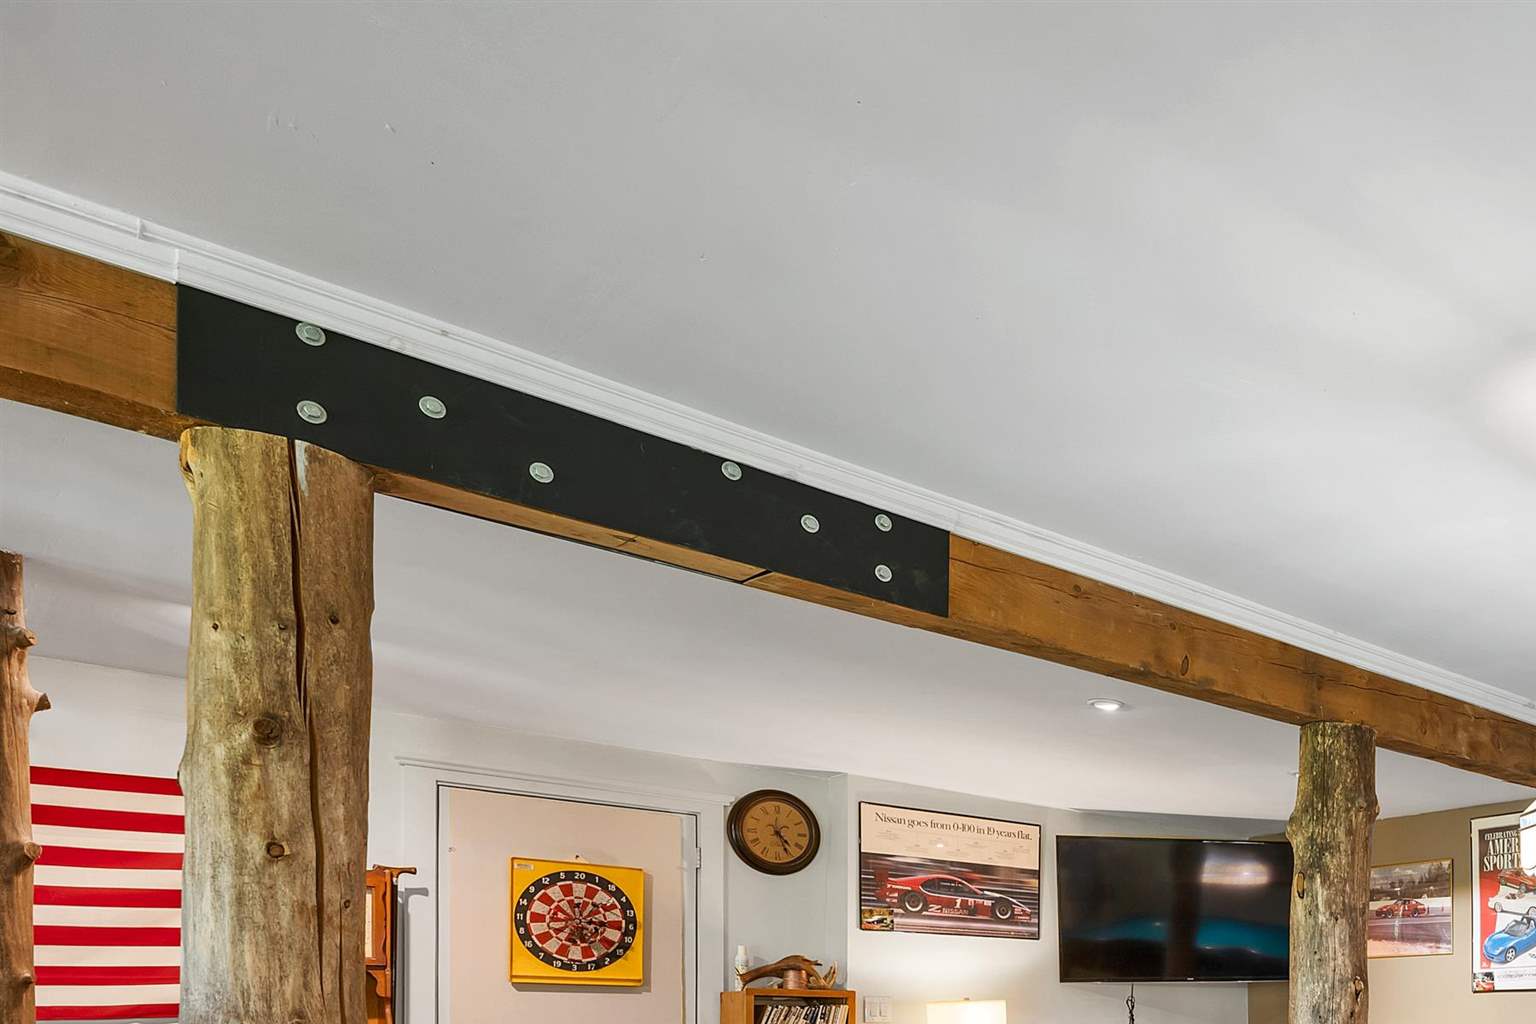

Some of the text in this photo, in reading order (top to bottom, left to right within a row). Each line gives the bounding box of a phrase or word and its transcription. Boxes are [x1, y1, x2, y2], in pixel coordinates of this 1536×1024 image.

[874, 812, 1033, 841] Nissan goes from 0-100 in 19 years flat.
[1485, 830, 1518, 841] CELEBRATING
